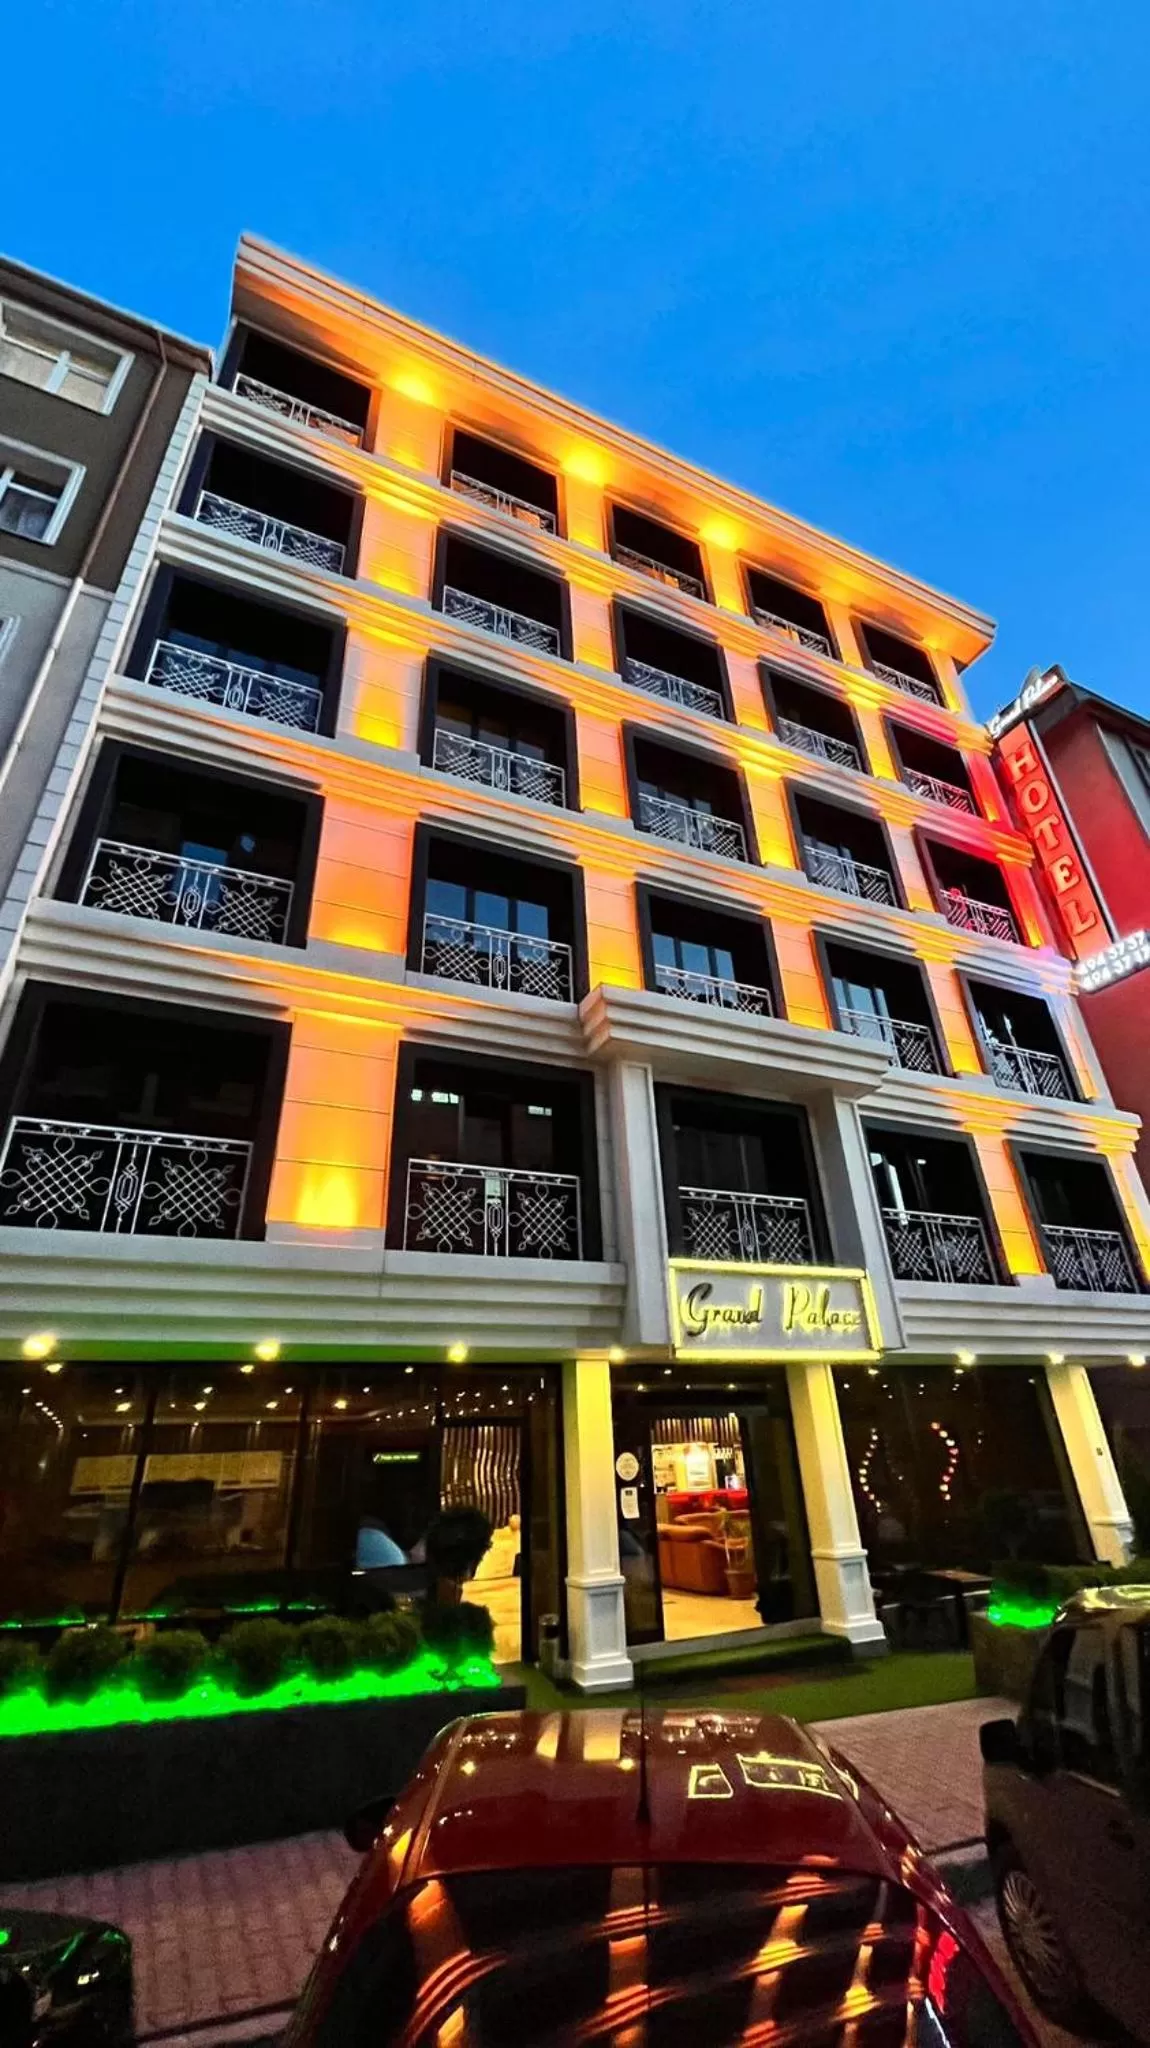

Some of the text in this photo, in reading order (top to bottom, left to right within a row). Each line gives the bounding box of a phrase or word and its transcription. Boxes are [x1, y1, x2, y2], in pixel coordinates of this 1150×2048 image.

[1008, 741, 1098, 937] HOTEL
[686, 1281, 862, 1337] Grand Palace
